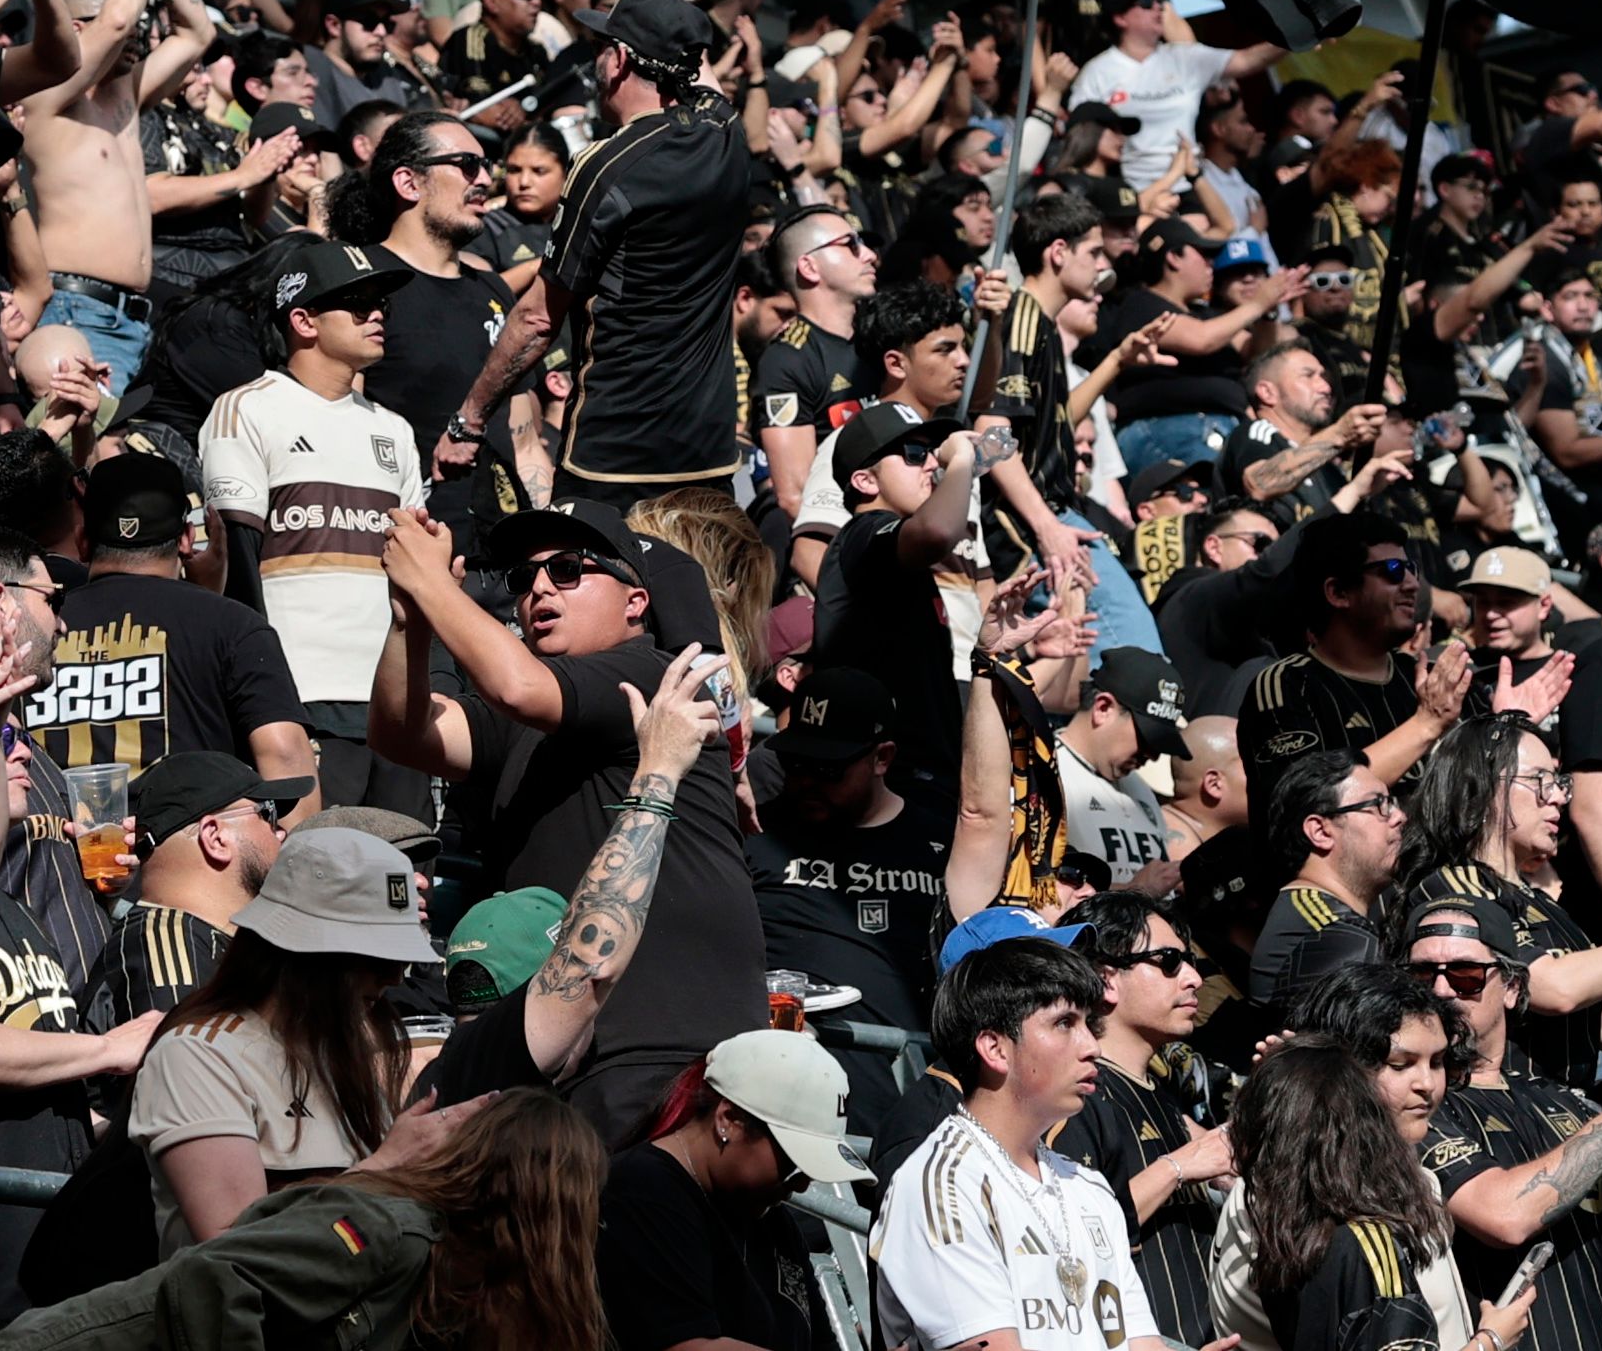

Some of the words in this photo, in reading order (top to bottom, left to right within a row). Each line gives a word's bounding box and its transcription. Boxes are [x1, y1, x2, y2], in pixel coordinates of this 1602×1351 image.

[270, 504, 325, 533] LOS
[80, 650, 109, 663] THE
[25, 656, 161, 728] 3252
[1100, 827, 1169, 864] FLEX
[783, 857, 838, 889] LA
[1022, 1297, 1083, 1335] BMO
